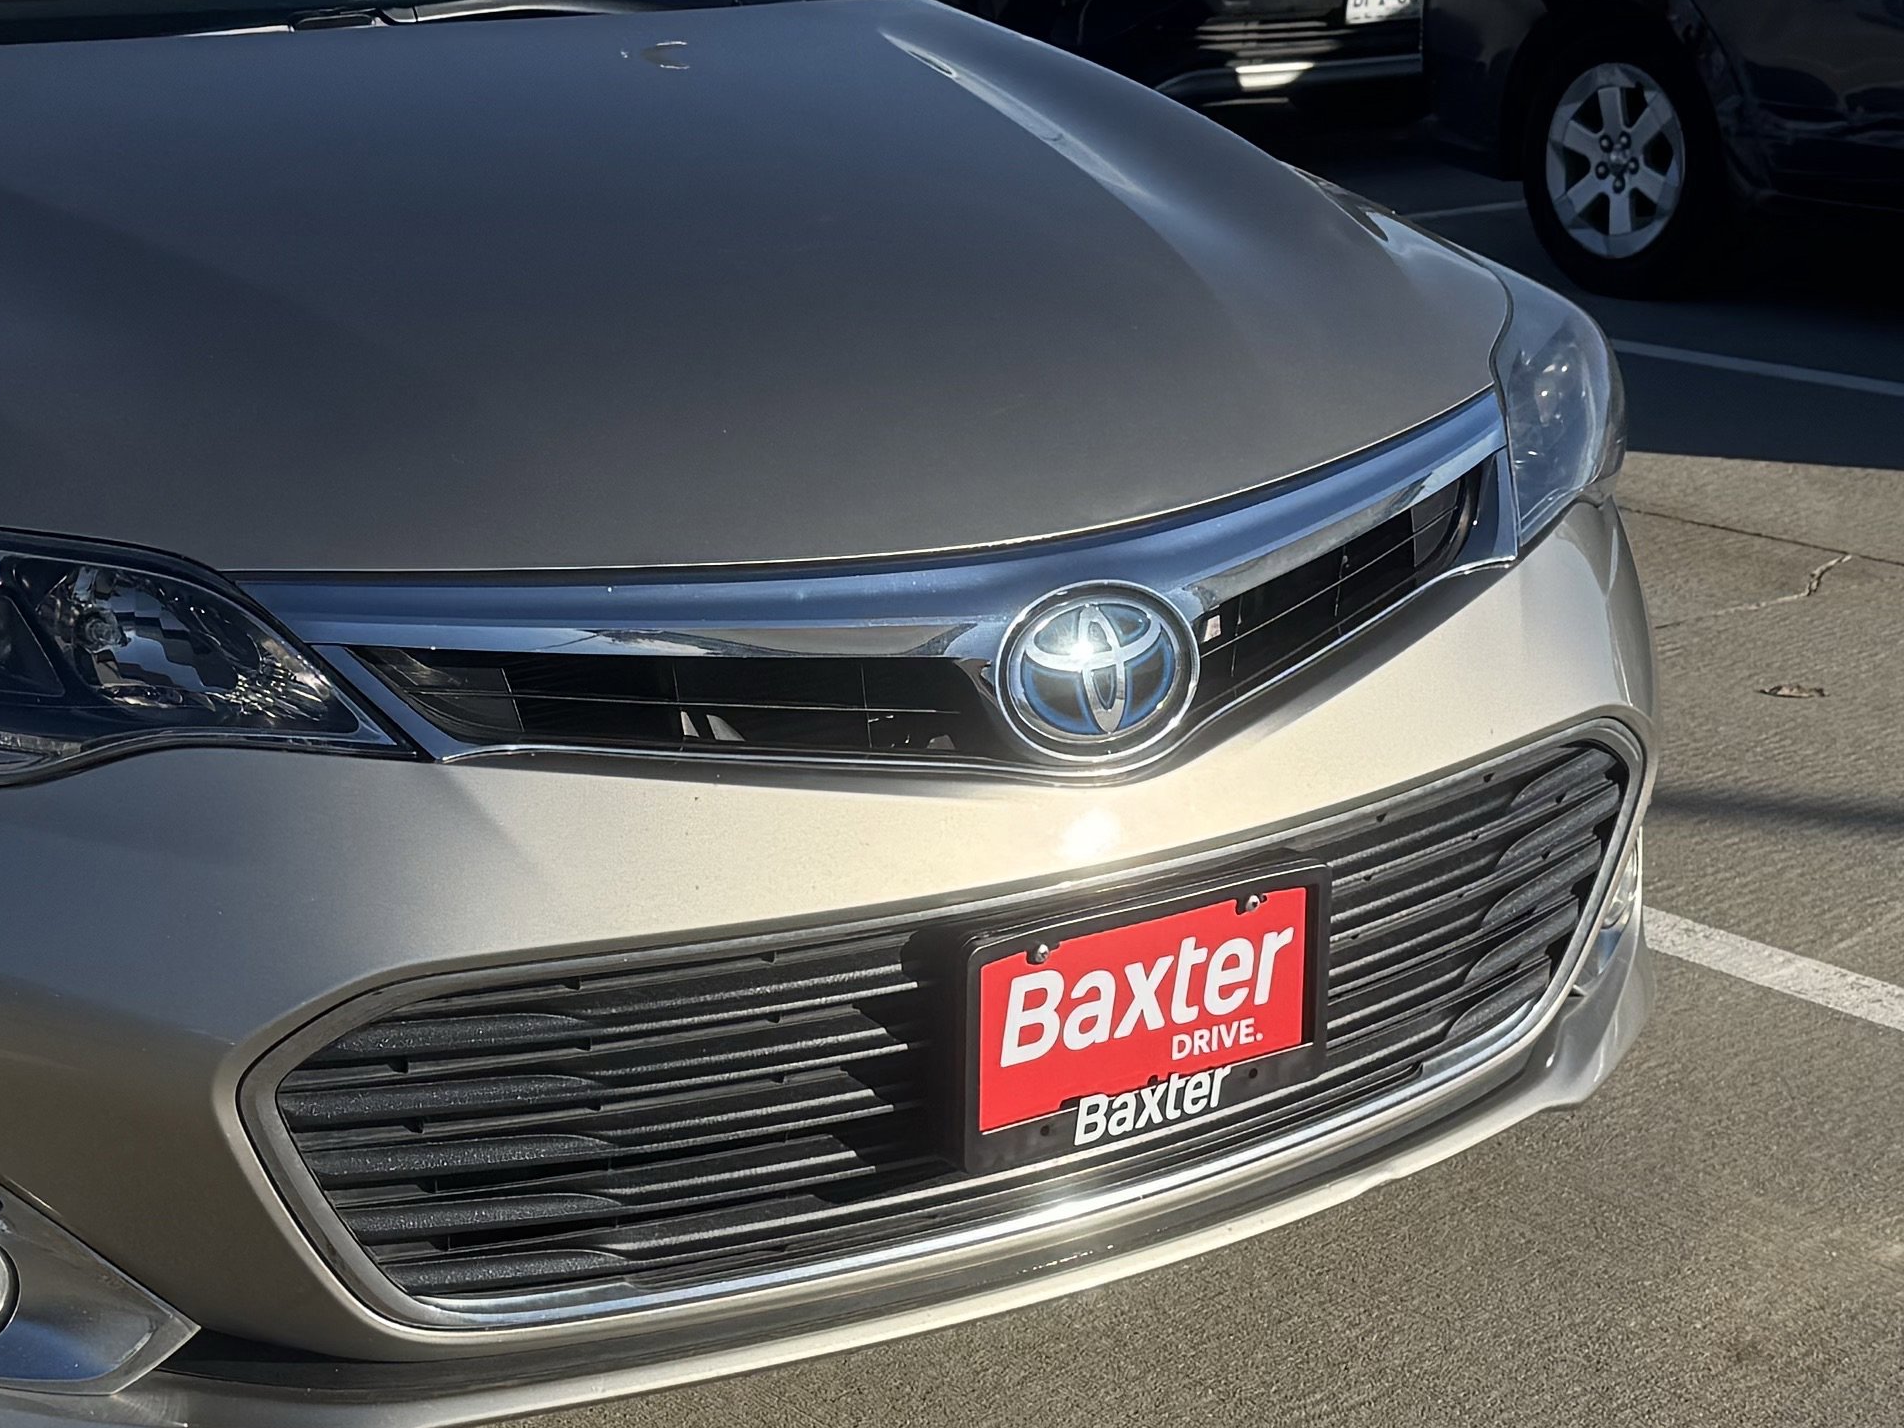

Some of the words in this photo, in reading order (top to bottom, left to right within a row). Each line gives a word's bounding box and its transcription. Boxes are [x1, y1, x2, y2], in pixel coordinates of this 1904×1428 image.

[1000, 926, 1294, 1068] Baxter
[1171, 1018, 1263, 1060] DRIVE.
[1074, 1066, 1232, 1146] Baxter
